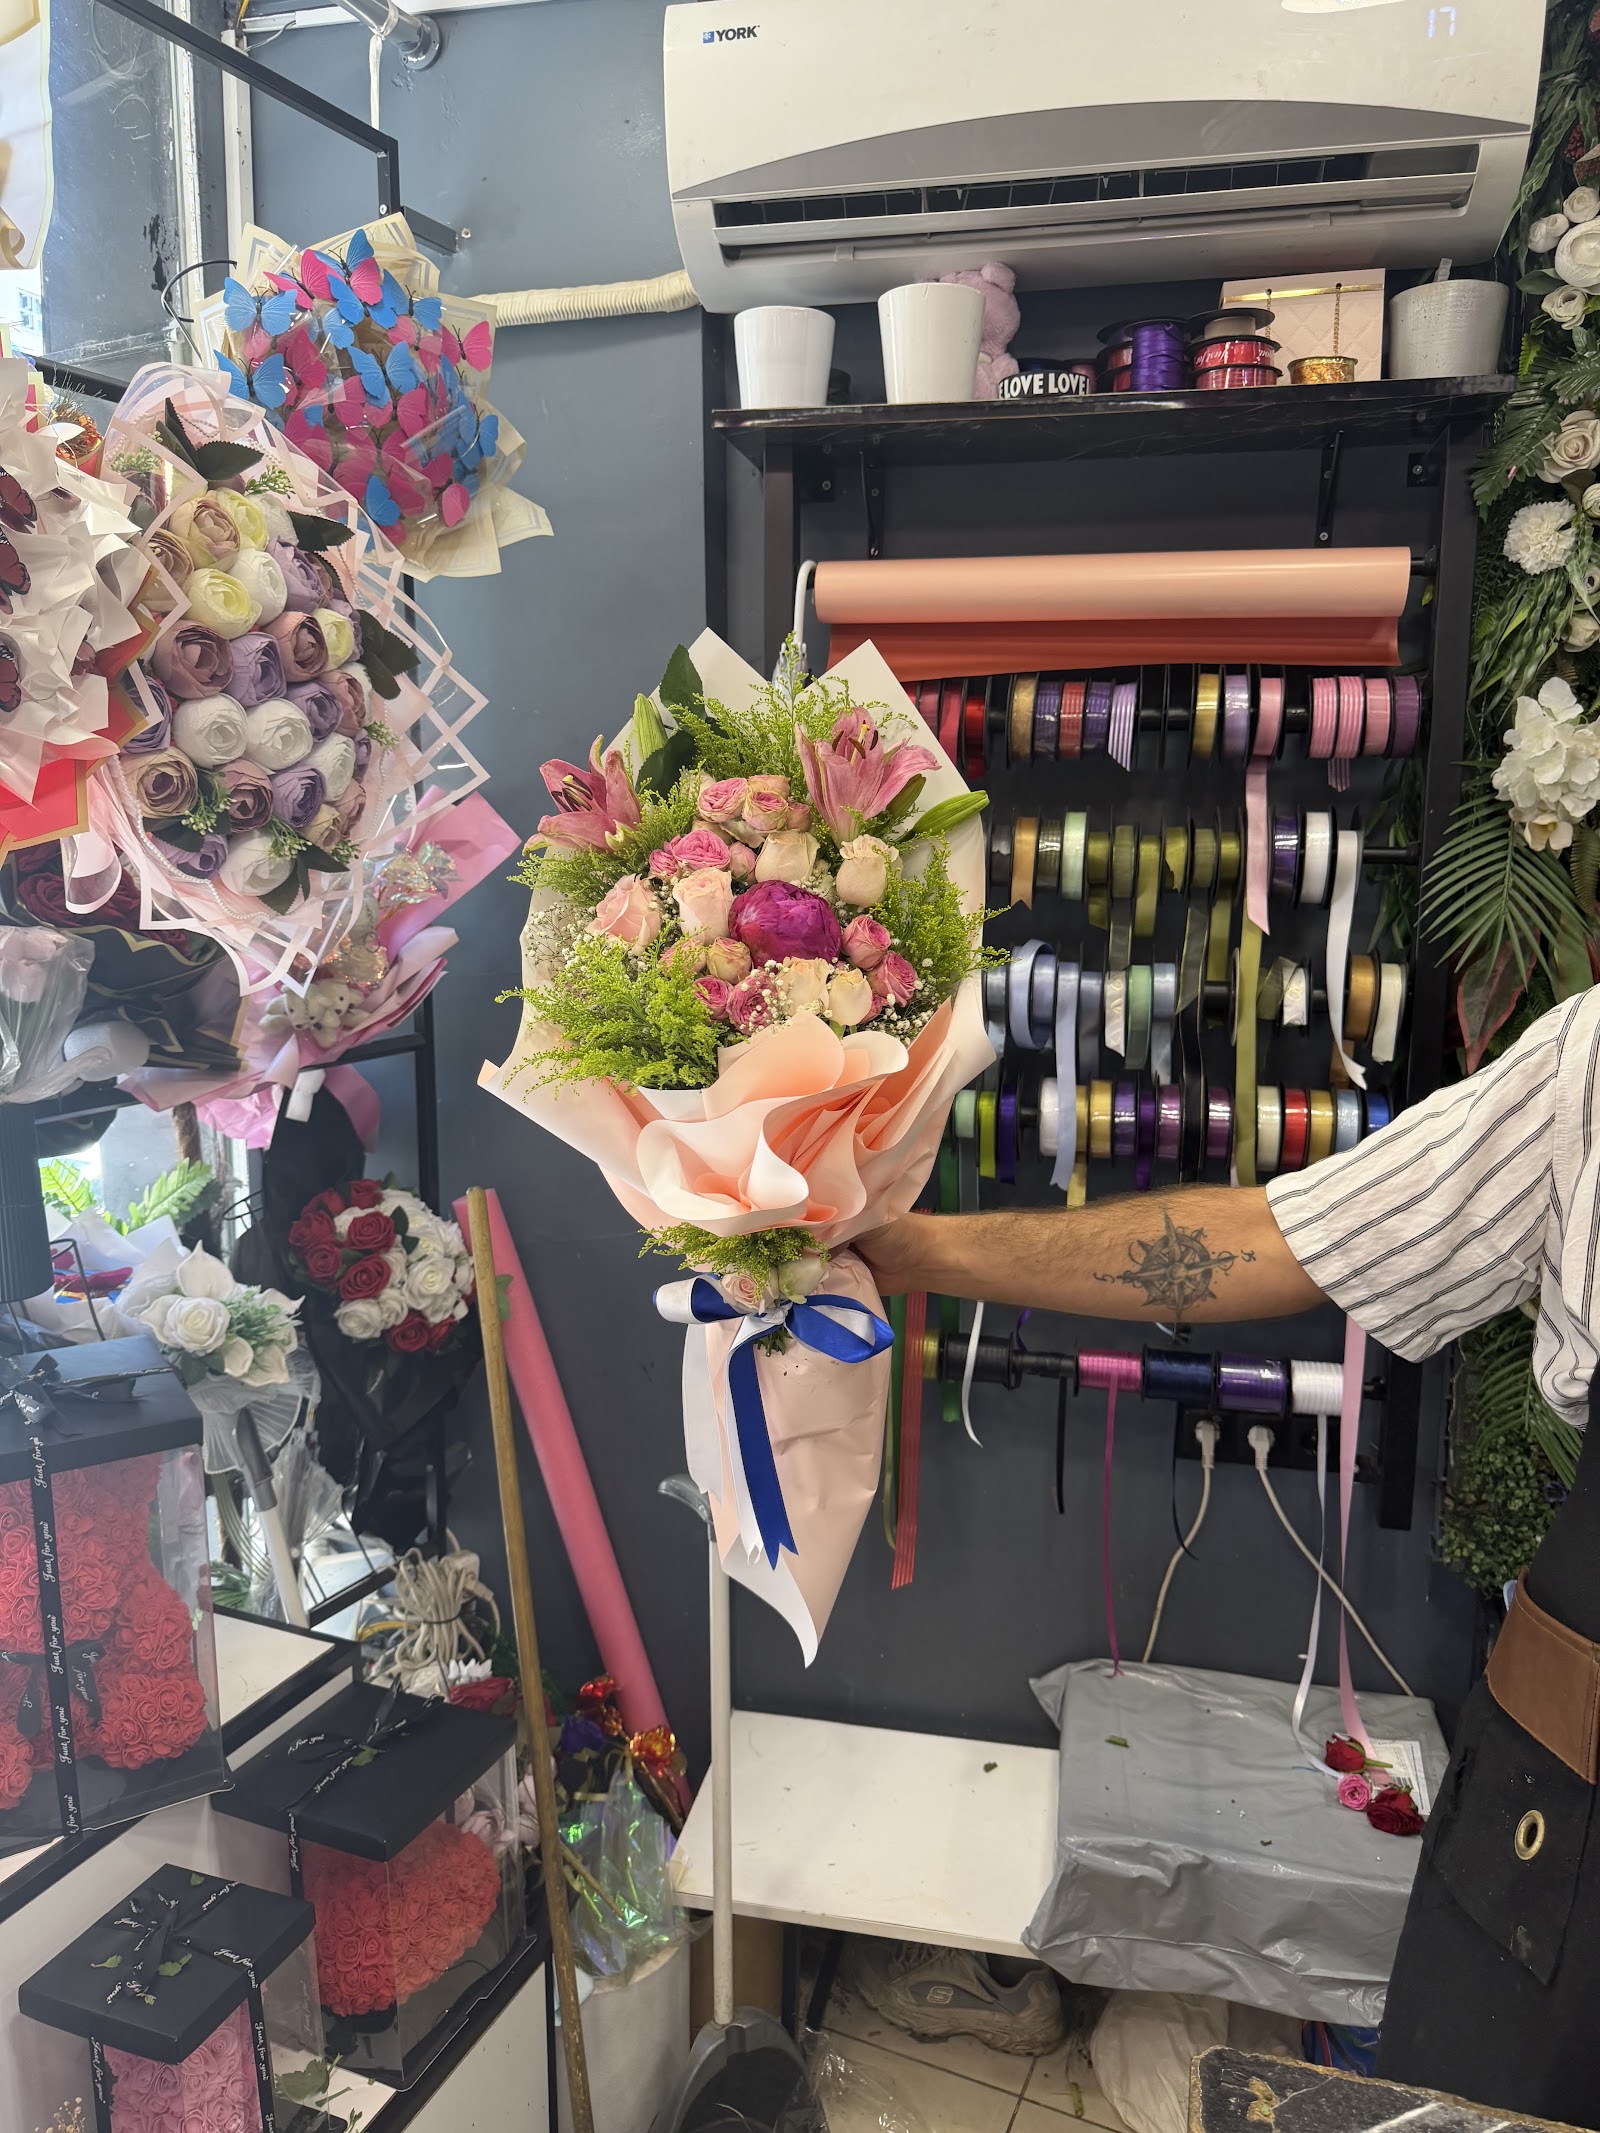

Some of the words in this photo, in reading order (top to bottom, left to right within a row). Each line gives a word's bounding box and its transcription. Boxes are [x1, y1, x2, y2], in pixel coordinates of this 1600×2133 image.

[1427, 6, 1456, 38] 17
[716, 25, 758, 41] YORK
[1003, 373, 1044, 399] LOVE
[1047, 373, 1086, 396] LOVE
[32, 1446, 46, 1465] for
[34, 1464, 48, 1488] Just
[39, 1521, 54, 1541] you
[41, 1542, 54, 1561] for
[43, 1559, 56, 1582] Just
[46, 1614, 60, 1634] you
[49, 1635, 62, 1653] for
[50, 1651, 64, 1674] Just
[55, 1705, 69, 1725] you
[58, 1726, 70, 1743] for
[59, 1742, 72, 1764] Just
[64, 1794, 78, 1813] you
[66, 1814, 79, 1831] for
[213, 1948, 240, 1961] Just
[232, 1958, 253, 1968] for
[255, 2022, 265, 2045] Just
[257, 2044, 266, 2061] for
